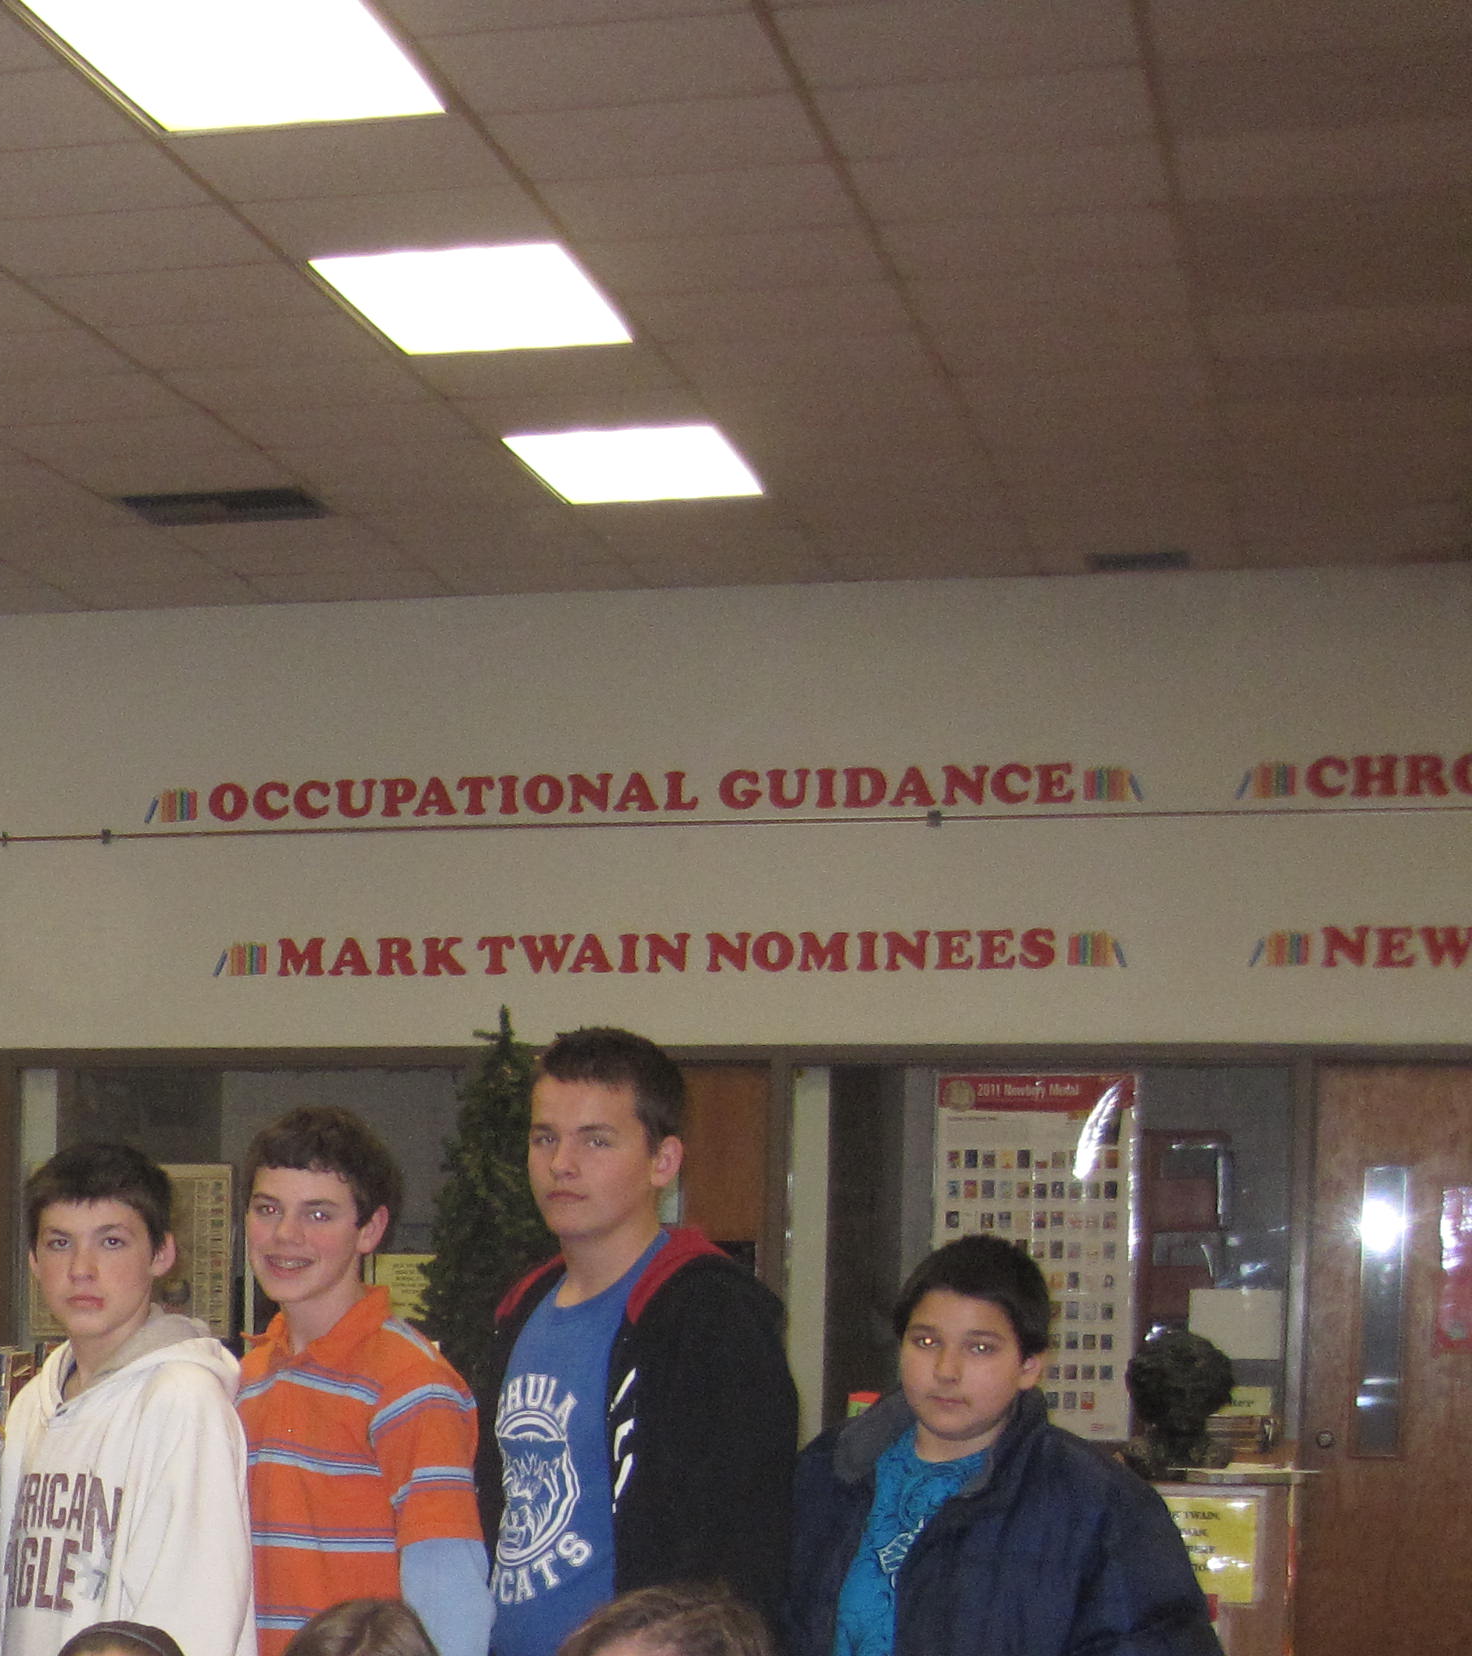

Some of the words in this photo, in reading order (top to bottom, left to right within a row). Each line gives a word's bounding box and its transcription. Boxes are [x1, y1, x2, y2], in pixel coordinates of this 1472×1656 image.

[209, 770, 699, 822] OCCUPATIONAL
[720, 762, 1073, 809] GUIDANCE
[278, 936, 467, 977] MARK
[476, 933, 691, 976] TWAIN
[705, 928, 1057, 973] NOMINEES
[976, 1083, 1001, 1097] 2011
